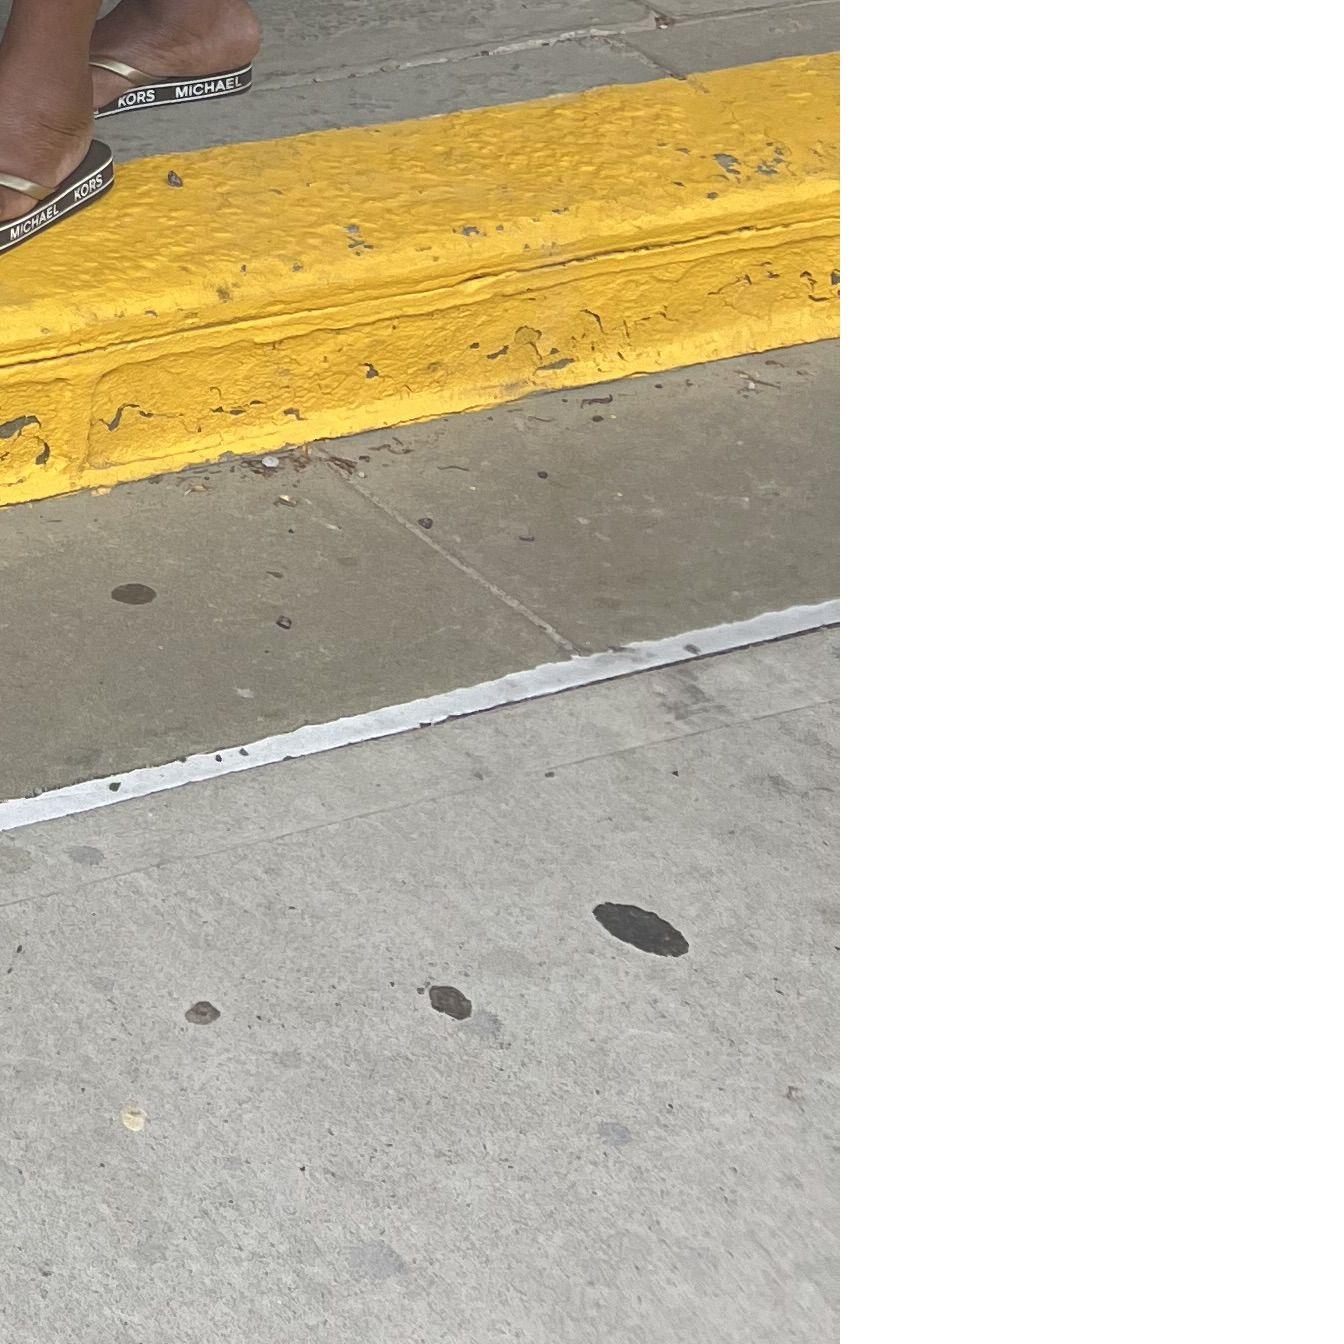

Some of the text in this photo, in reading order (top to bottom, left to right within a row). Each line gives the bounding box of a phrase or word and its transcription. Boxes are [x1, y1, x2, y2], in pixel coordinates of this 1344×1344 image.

[117, 76, 243, 108] KORS MICHAEL
[9, 204, 60, 241] MICHAEL
[73, 173, 104, 201] KORS
